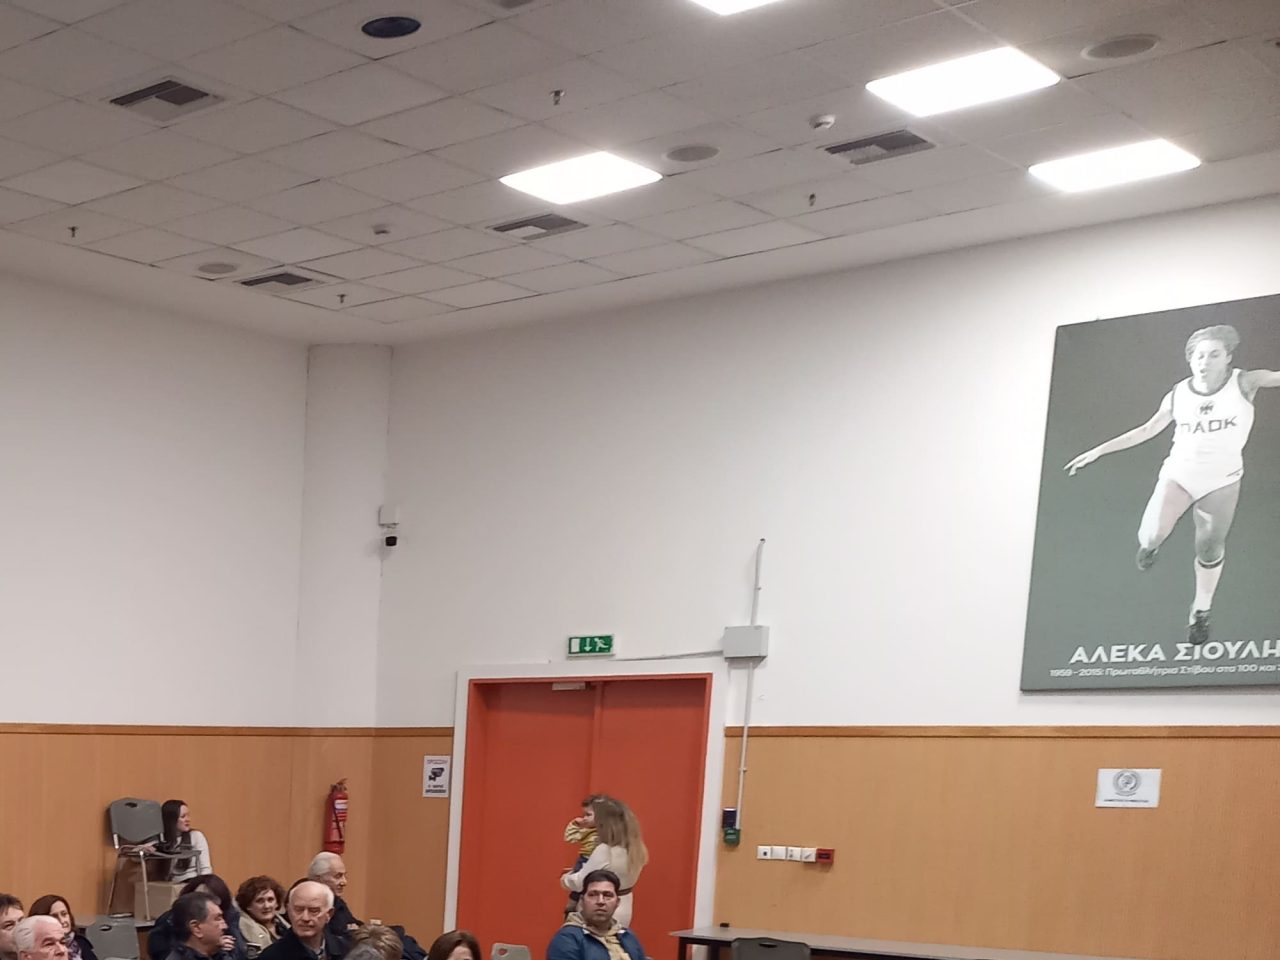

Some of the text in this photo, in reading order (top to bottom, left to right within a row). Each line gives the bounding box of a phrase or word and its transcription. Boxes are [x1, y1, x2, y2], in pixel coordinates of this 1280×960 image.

[1069, 640, 1280, 664] ΑΛΕΚΑ ΣΙΟΥΛΗ
[1238, 664, 1257, 672] 100
[1259, 664, 1276, 672] και
